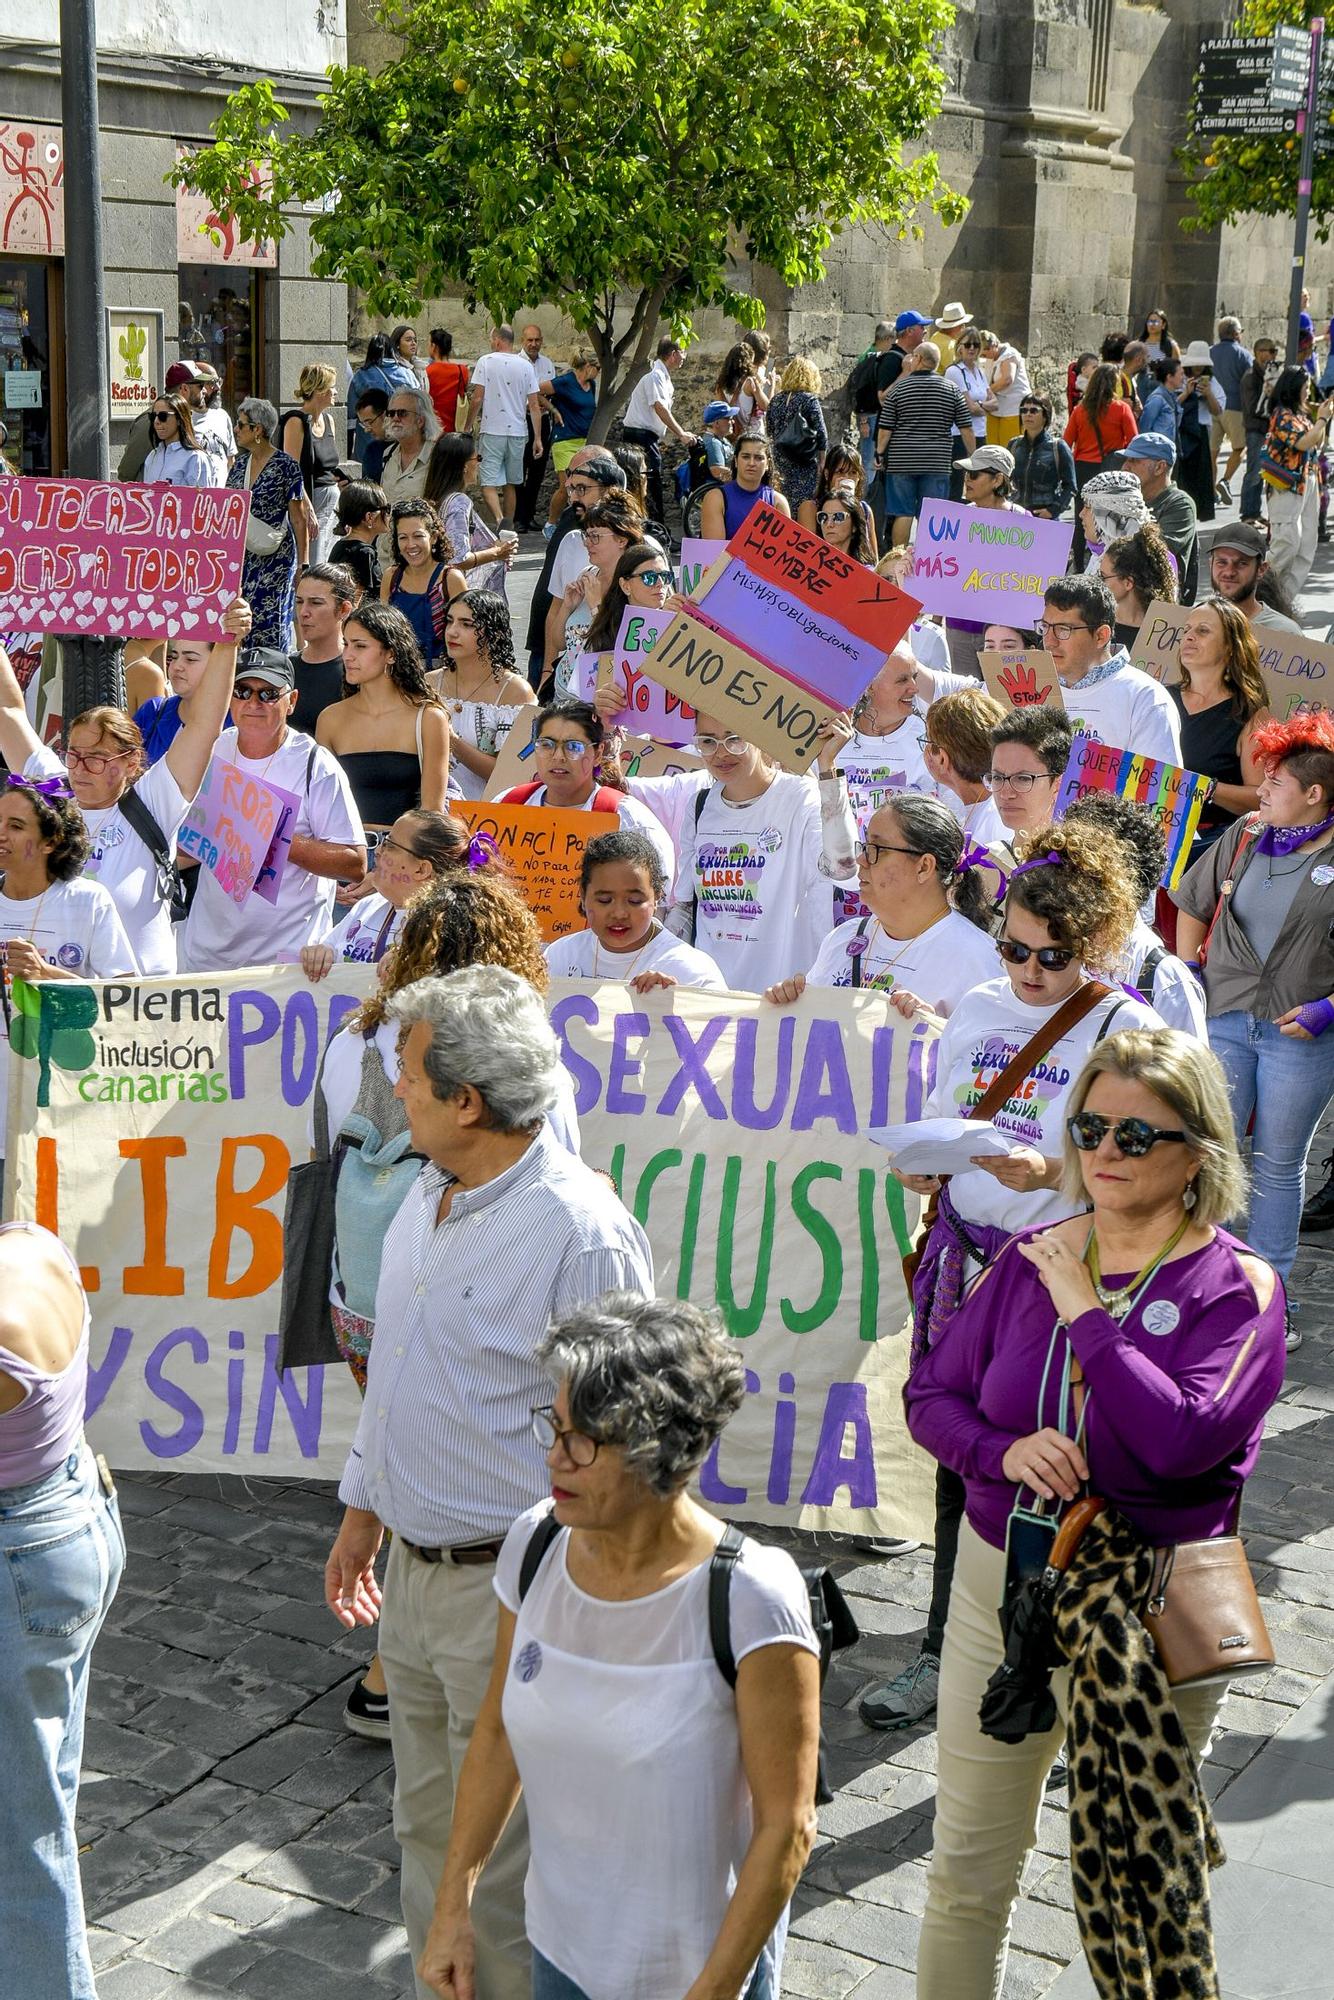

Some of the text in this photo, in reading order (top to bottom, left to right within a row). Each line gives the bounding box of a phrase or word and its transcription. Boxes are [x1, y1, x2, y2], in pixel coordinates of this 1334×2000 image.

[1208, 39, 1231, 50] PLAZA
[1232, 38, 1245, 48] DEL
[1236, 58, 1255, 69] CASA
[1202, 117, 1226, 128] CENTRO
[1227, 117, 1247, 127] ARTES
[111, 381, 157, 400] Kactu's
[191, 493, 246, 540] UNA
[928, 514, 1035, 550] UN MUNDO
[0, 543, 80, 595] OCAS
[914, 551, 959, 578] MÁS
[725, 670, 768, 706] ES
[714, 845, 744, 855] POR UNA
[702, 869, 744, 887] LIBRE
[102, 985, 225, 1022] Plena
[99, 1036, 215, 1071] inclusión
[1001, 1043, 1021, 1054] POR
[79, 1072, 229, 1104] canarias
[36, 1134, 291, 1299] LIB
